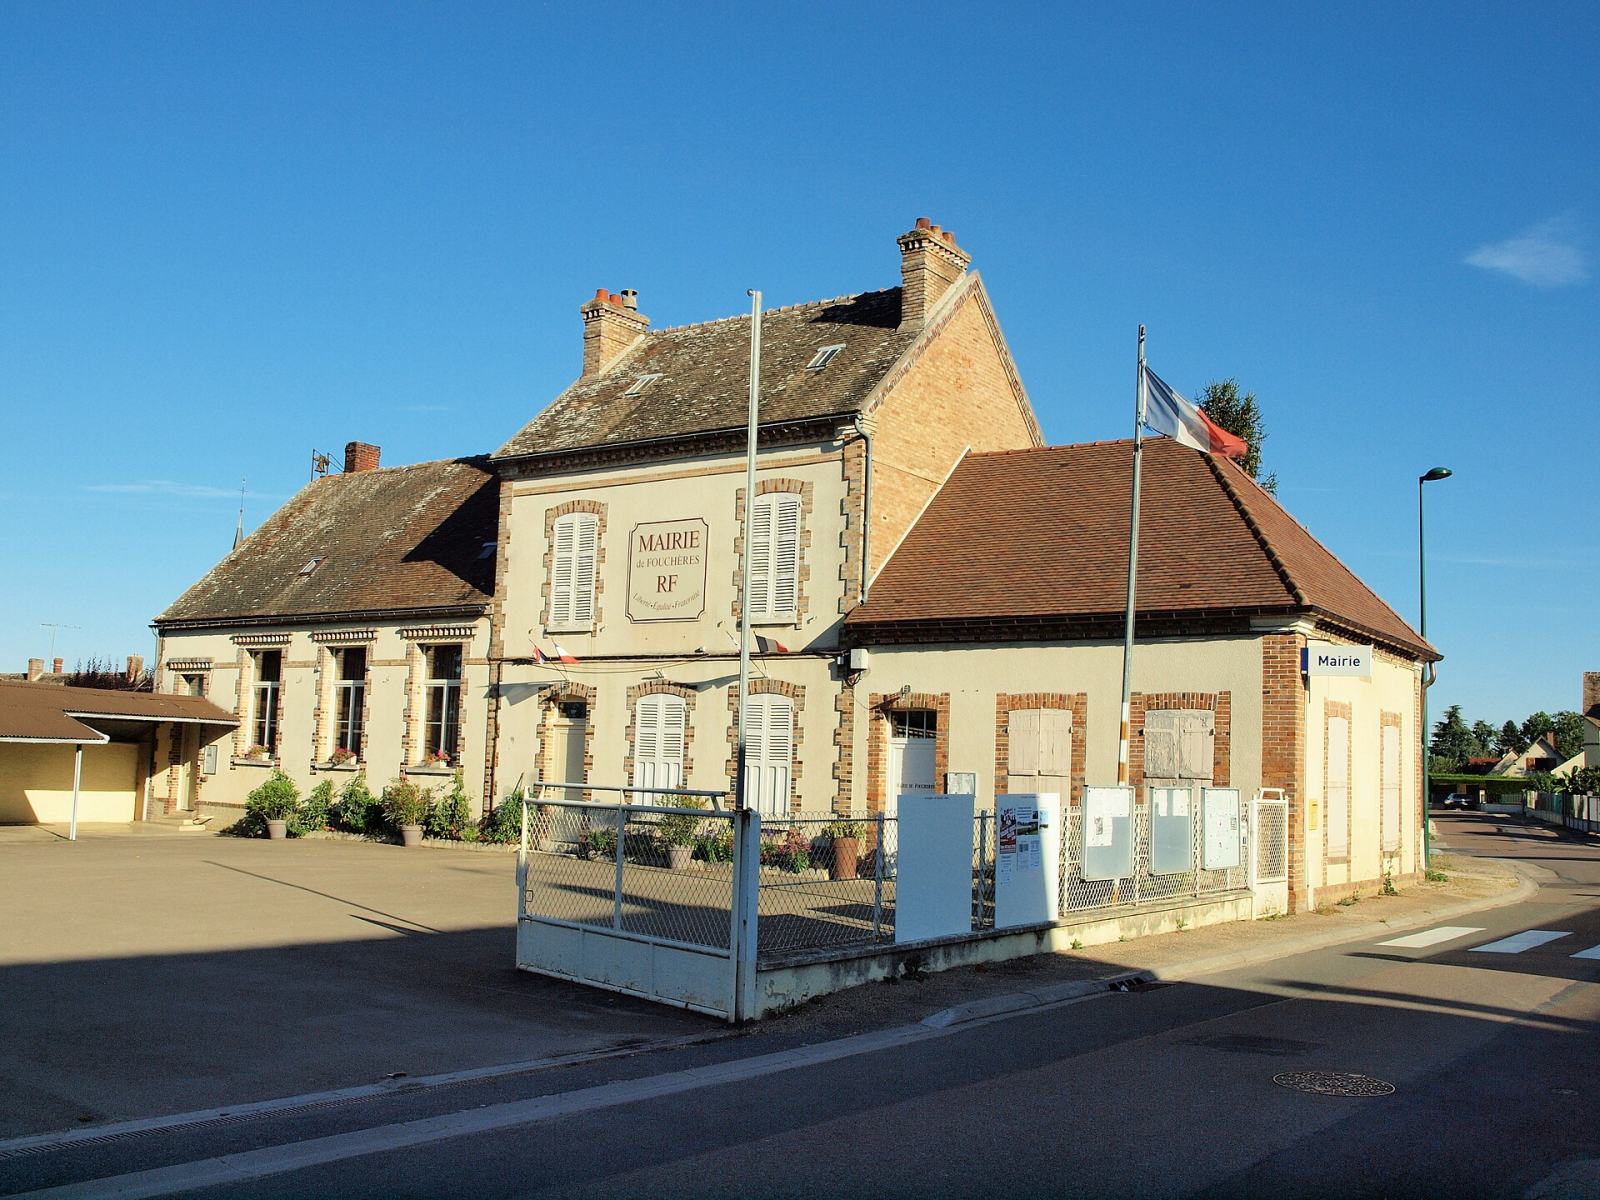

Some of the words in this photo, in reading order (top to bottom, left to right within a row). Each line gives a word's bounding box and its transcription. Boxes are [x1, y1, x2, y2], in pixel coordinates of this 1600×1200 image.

[638, 530, 700, 552] MAIRIE
[636, 559, 645, 568] de
[647, 554, 700, 567] FOUCHÈRES
[656, 574, 678, 593] RF
[1318, 655, 1361, 667] Mairie
